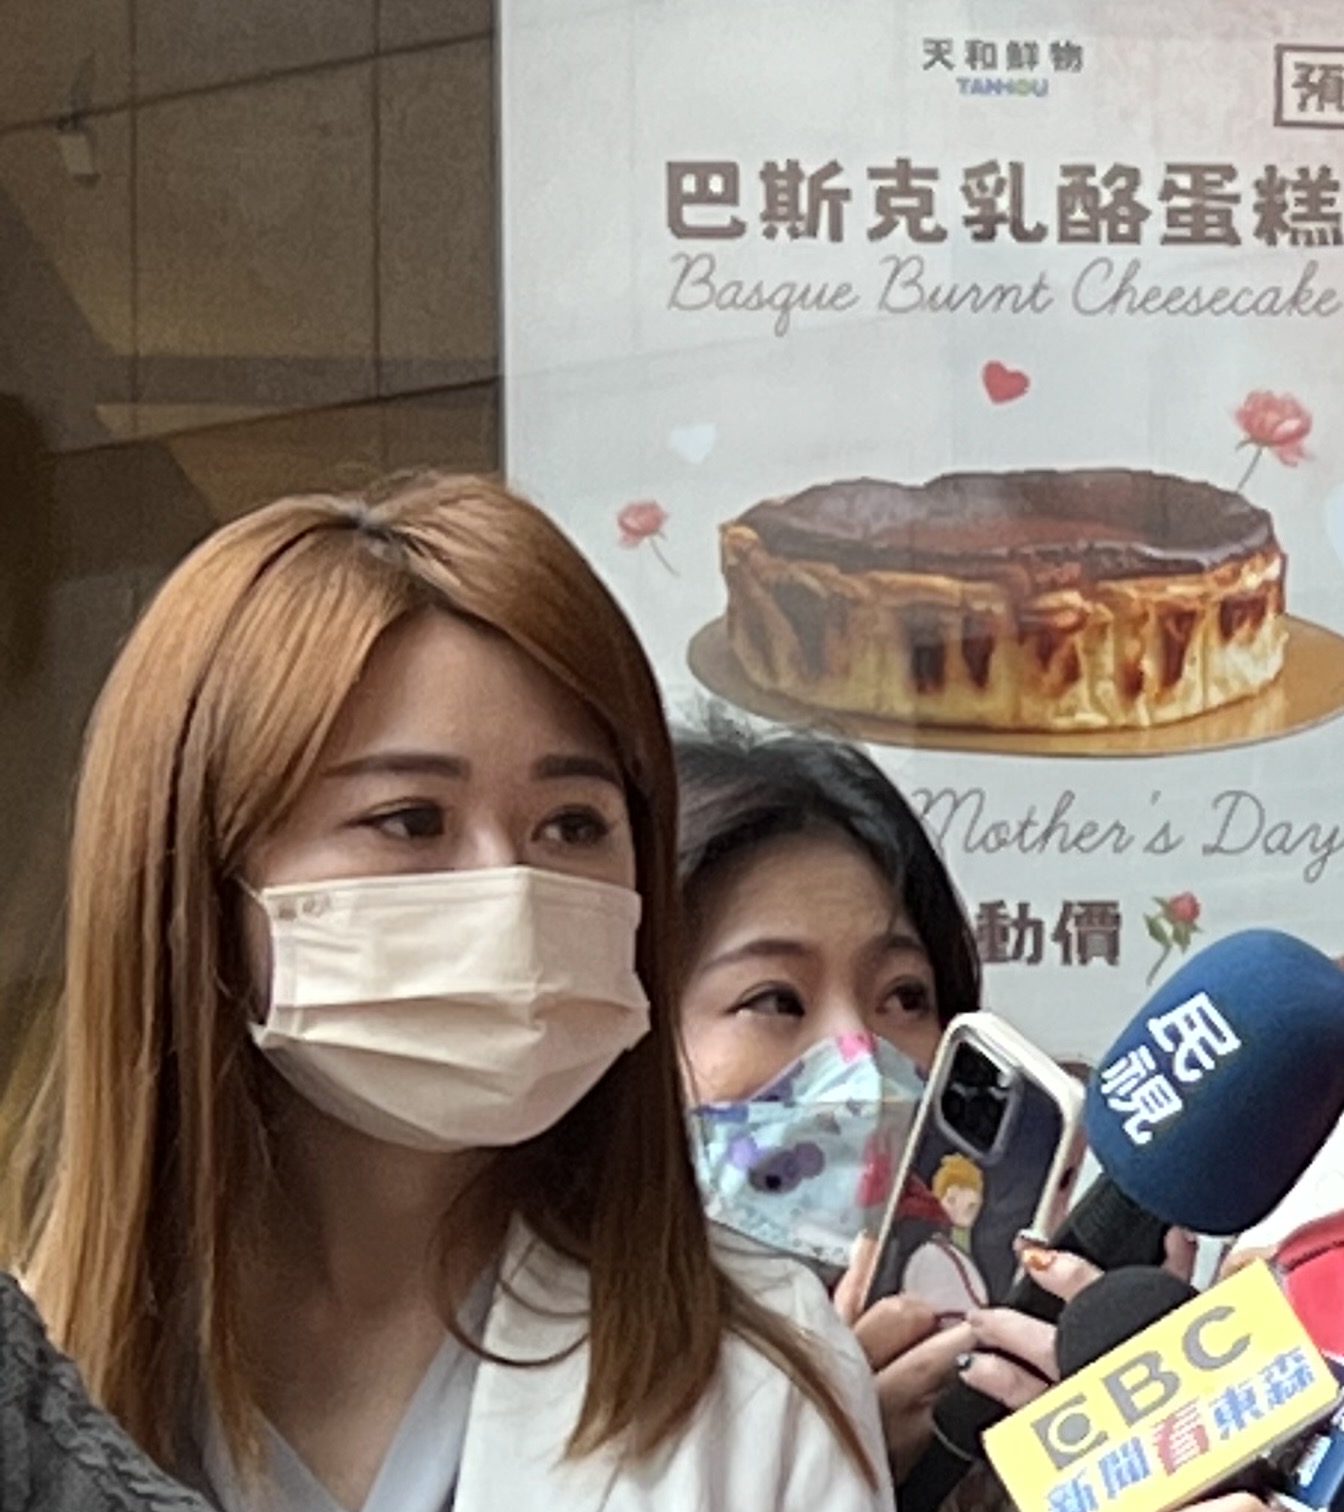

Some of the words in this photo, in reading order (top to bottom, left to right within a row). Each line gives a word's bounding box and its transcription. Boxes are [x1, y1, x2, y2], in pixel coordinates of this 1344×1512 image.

[922, 37, 1083, 73] 天和鮮物
[666, 157, 1344, 246] 巴斯克乳酪蛋糕
[667, 252, 860, 337] Basque
[878, 254, 1054, 314] Burnt
[1072, 256, 1344, 317] Cheesecake
[911, 787, 1184, 856] Mother's
[1101, 992, 1241, 1144] 民視
